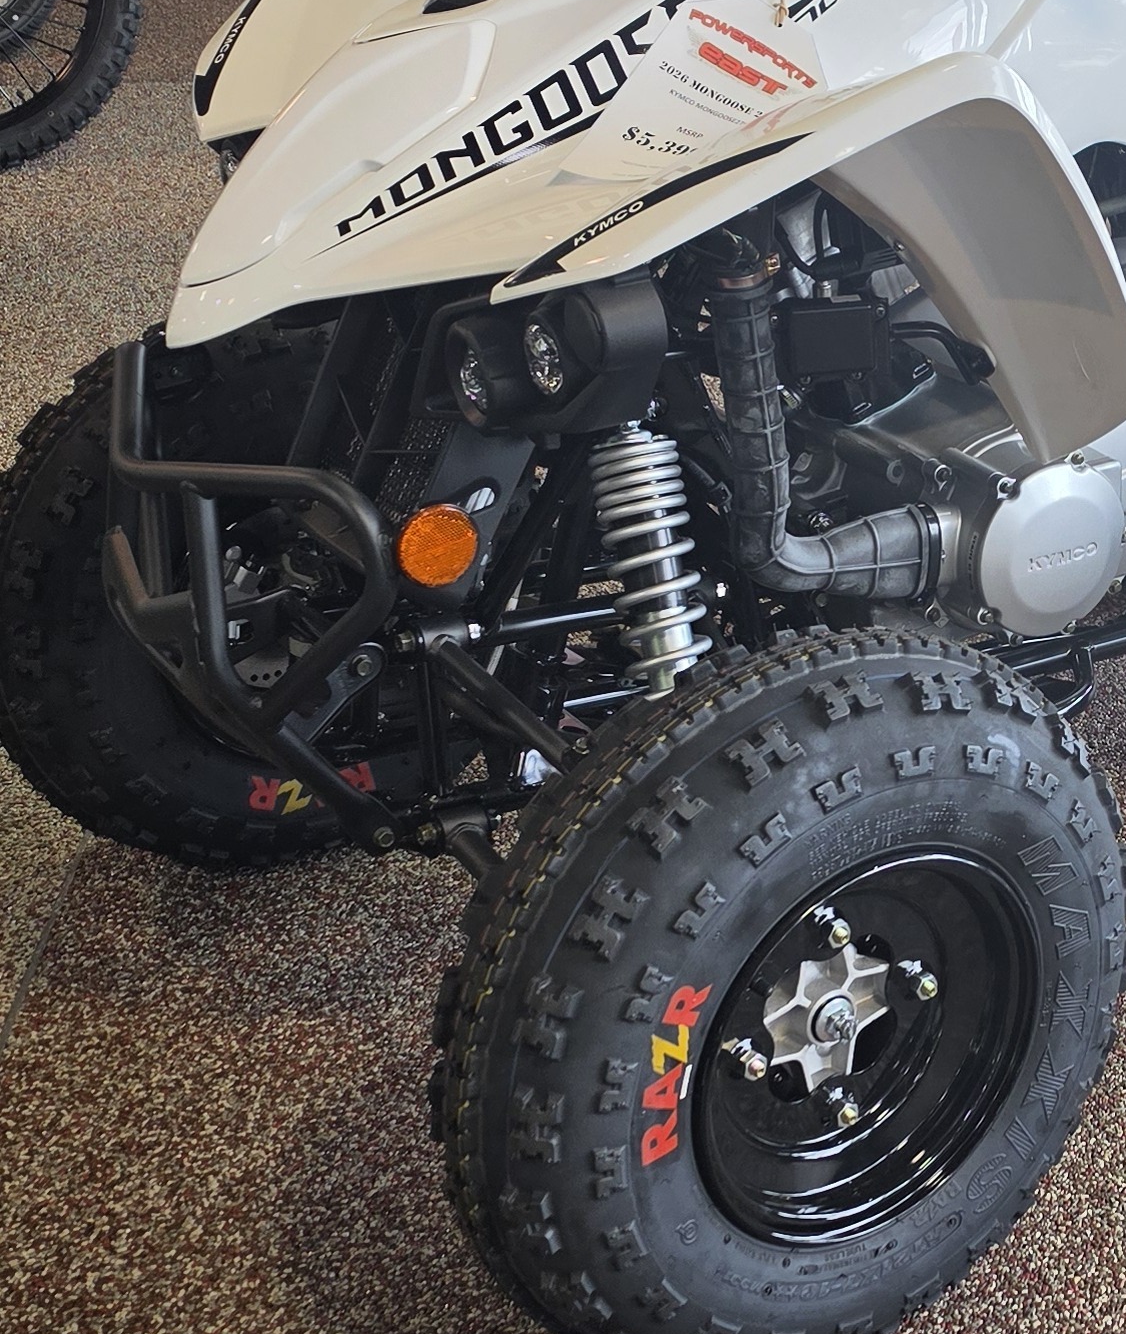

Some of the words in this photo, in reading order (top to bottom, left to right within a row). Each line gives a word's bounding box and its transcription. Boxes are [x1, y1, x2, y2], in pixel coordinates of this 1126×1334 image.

[213, 15, 247, 64] KYMCO
[658, 60, 688, 85] 2026
[688, 78, 756, 115] MONGOOSE
[668, 88, 697, 108] KYMCO
[694, 101, 748, 127] MONGOOSE27
[675, 126, 705, 140] MSRP
[573, 200, 645, 248] KYMCO
[1027, 541, 1098, 573] KYMCO
[249, 761, 377, 816] RZR
[641, 983, 714, 1168] RAZR
